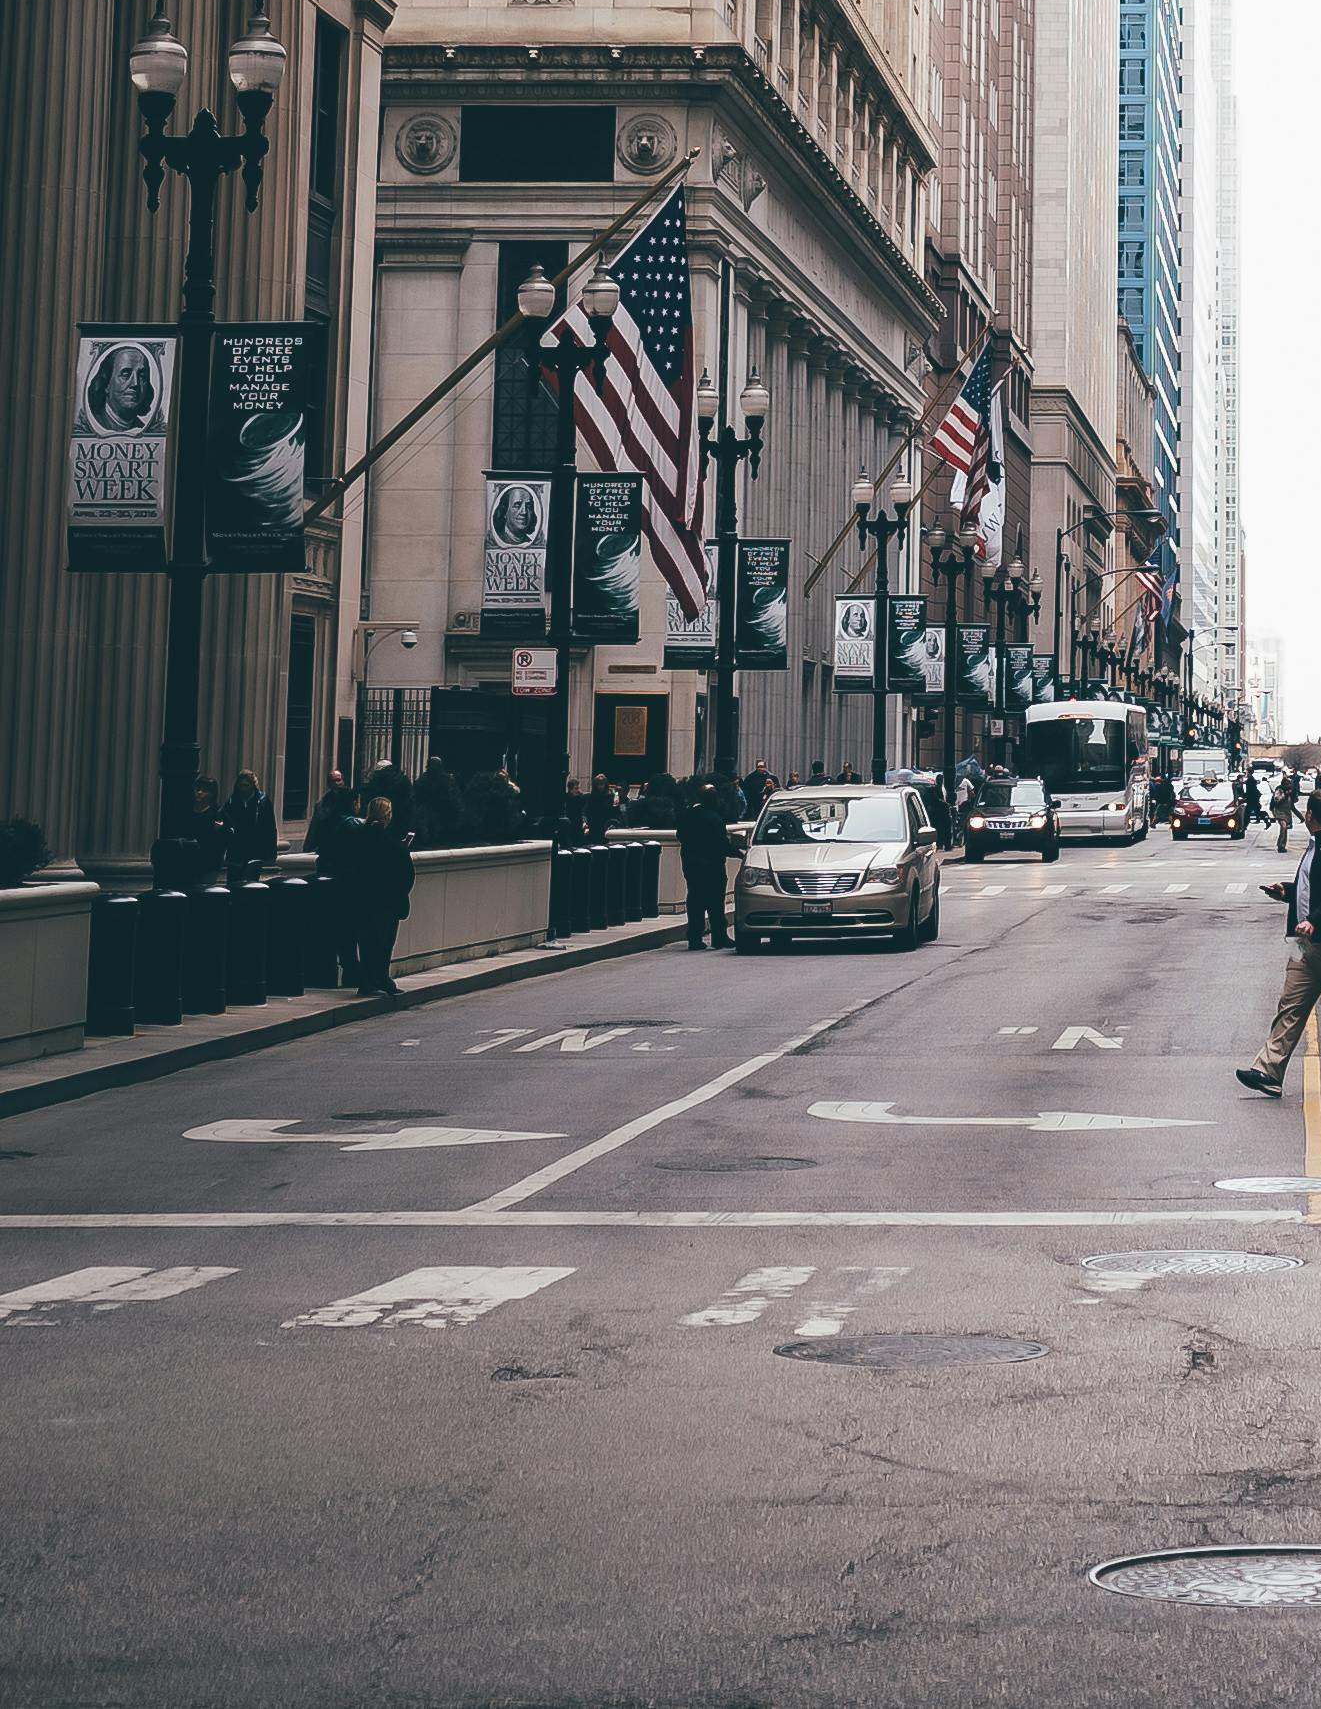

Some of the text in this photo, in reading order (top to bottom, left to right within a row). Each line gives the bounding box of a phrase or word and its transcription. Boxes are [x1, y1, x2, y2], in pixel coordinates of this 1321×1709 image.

[223, 337, 303, 346] HUNDREDS
[232, 346, 293, 355] OF FREE
[233, 355, 290, 364] EVENTS
[229, 365, 293, 373] TO HELP
[246, 374, 275, 382] YOU
[229, 383, 290, 391] MANAGE
[240, 392, 279, 400] YOUR
[233, 401, 284, 410] MONEY
[76, 442, 159, 460] MONEY
[74, 460, 158, 479] SMART
[74, 479, 158, 500] WEEK
[487, 552, 542, 564] MONEY
[486, 563, 542, 578] SMART
[486, 577, 541, 591] WEEK
